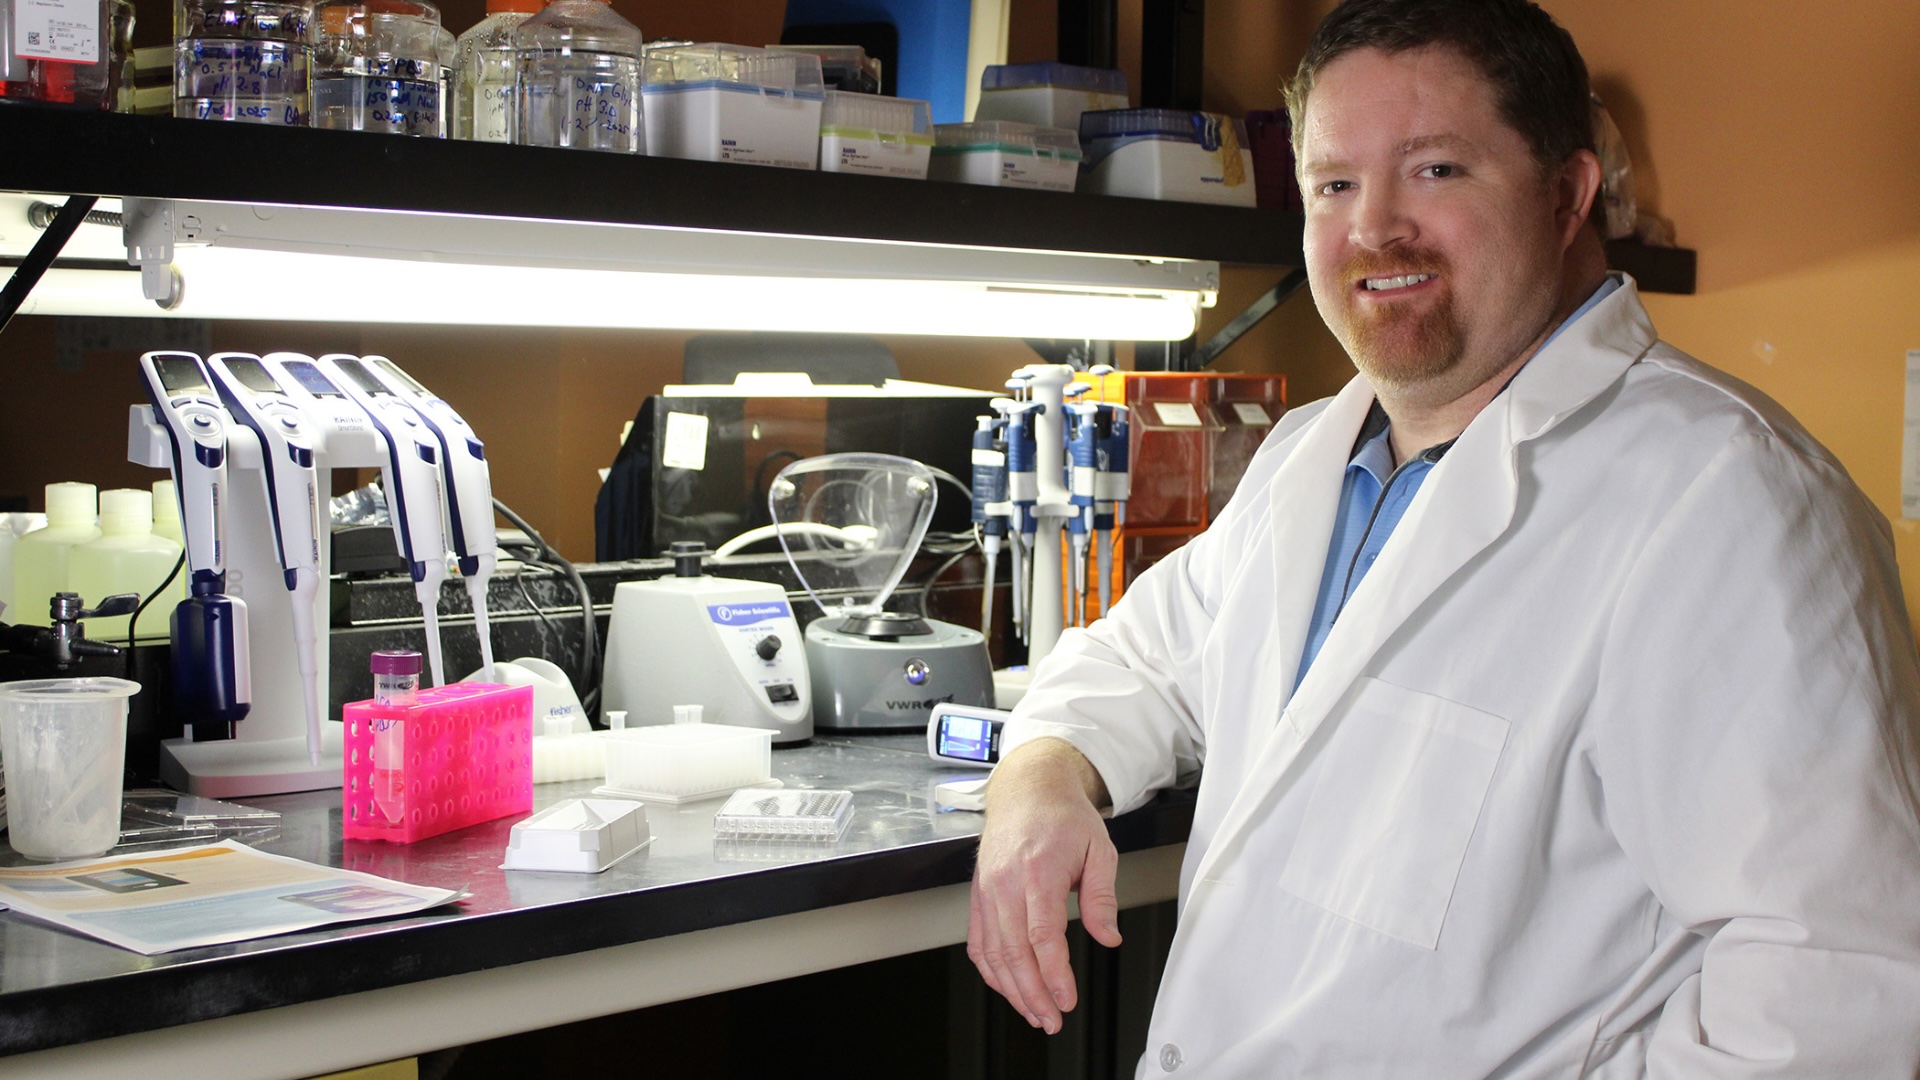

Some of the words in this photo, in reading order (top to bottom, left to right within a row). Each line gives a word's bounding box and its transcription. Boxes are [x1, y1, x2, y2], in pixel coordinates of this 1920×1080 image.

[236, 76, 261, 95] 2.8
[575, 95, 592, 112] pH
[598, 99, 618, 118] 3.0
[731, 607, 752, 616] Fisher
[752, 606, 781, 615] Scientific
[885, 700, 922, 710] VWR
